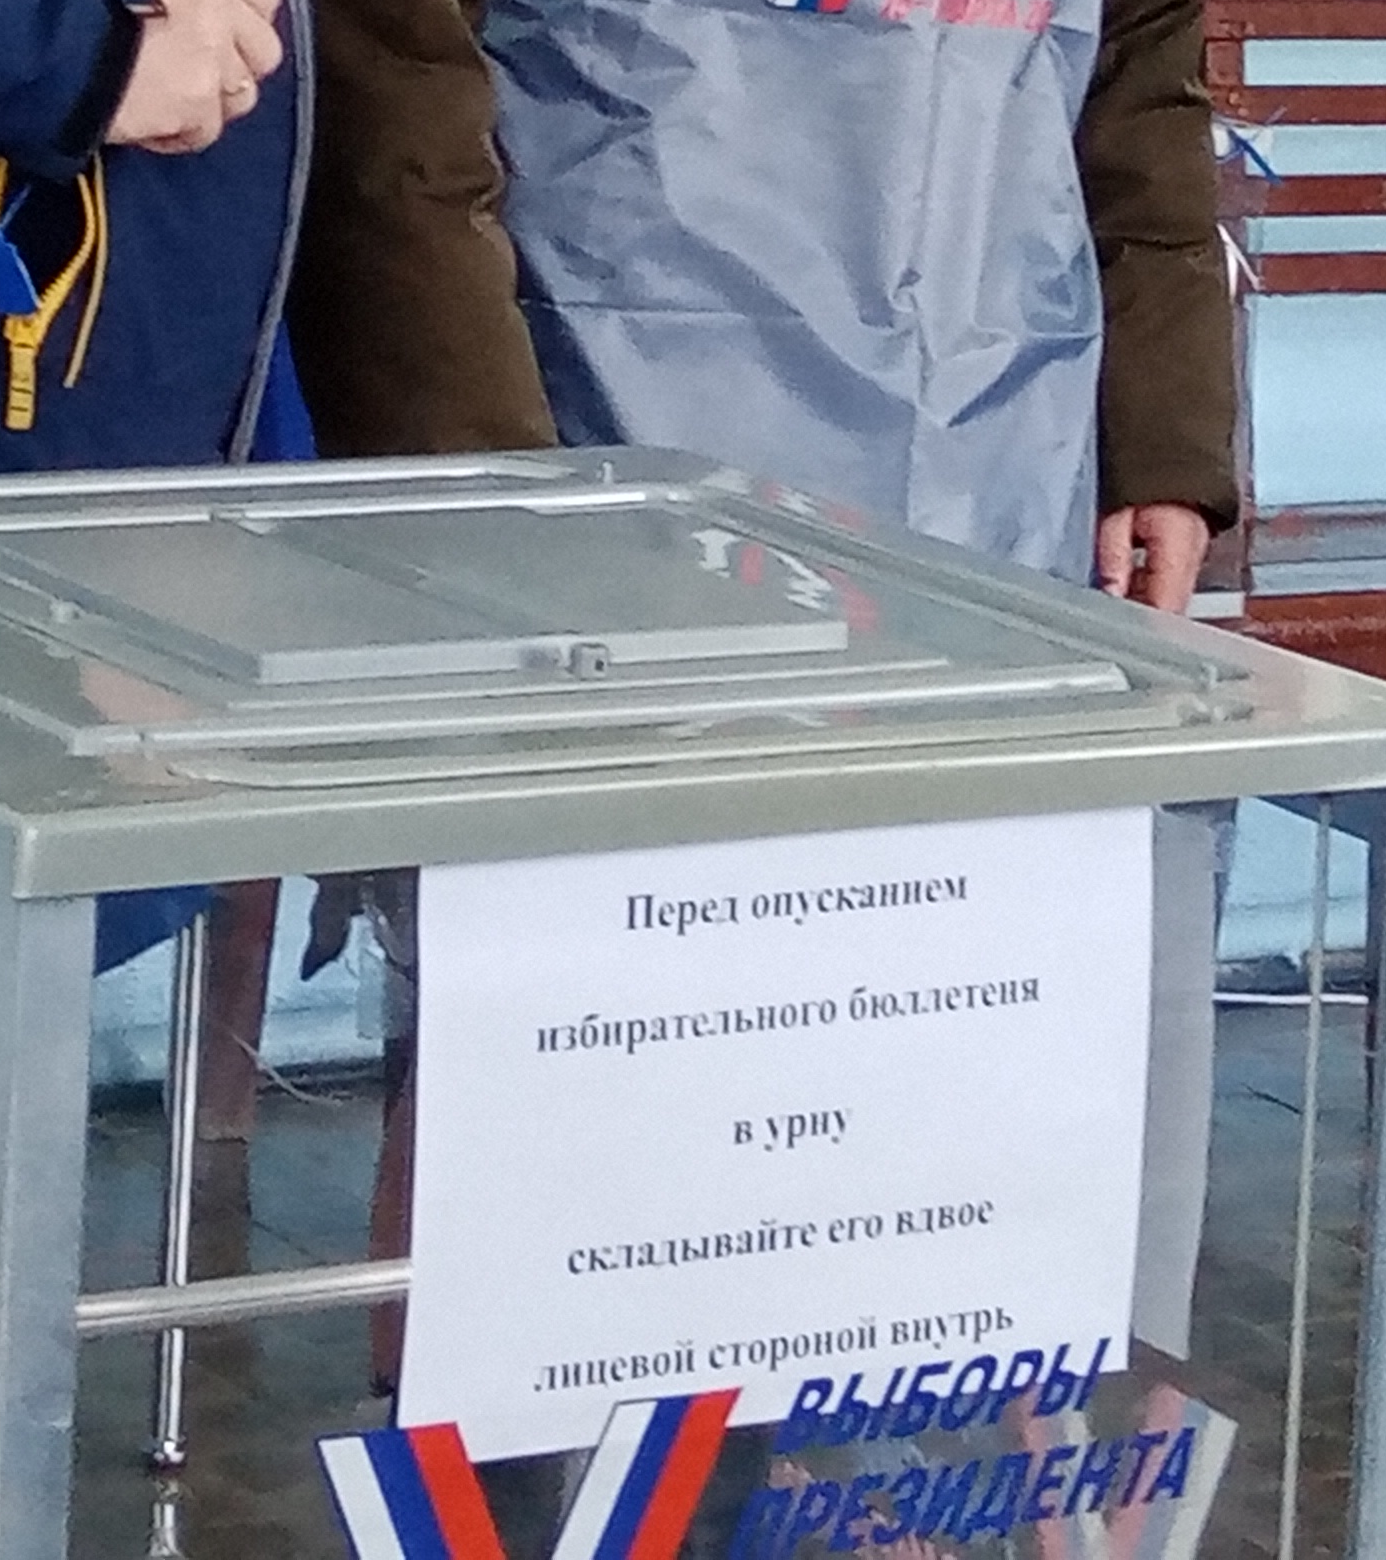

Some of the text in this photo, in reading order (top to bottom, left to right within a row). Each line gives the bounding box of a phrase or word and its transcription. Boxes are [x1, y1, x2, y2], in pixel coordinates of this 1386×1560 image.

[625, 874, 968, 935] Перед опусканием
[536, 975, 1041, 1055] избирательного бюллетеня
[732, 1105, 852, 1151] в урну
[567, 1198, 995, 1276] складывайте его вдвое
[533, 1303, 1013, 1393] лицевой стороной внутрь
[772, 1337, 1113, 1453] ВЫБОРЫ
[727, 1426, 1197, 1559] ПРЕЗИДЕНТА
